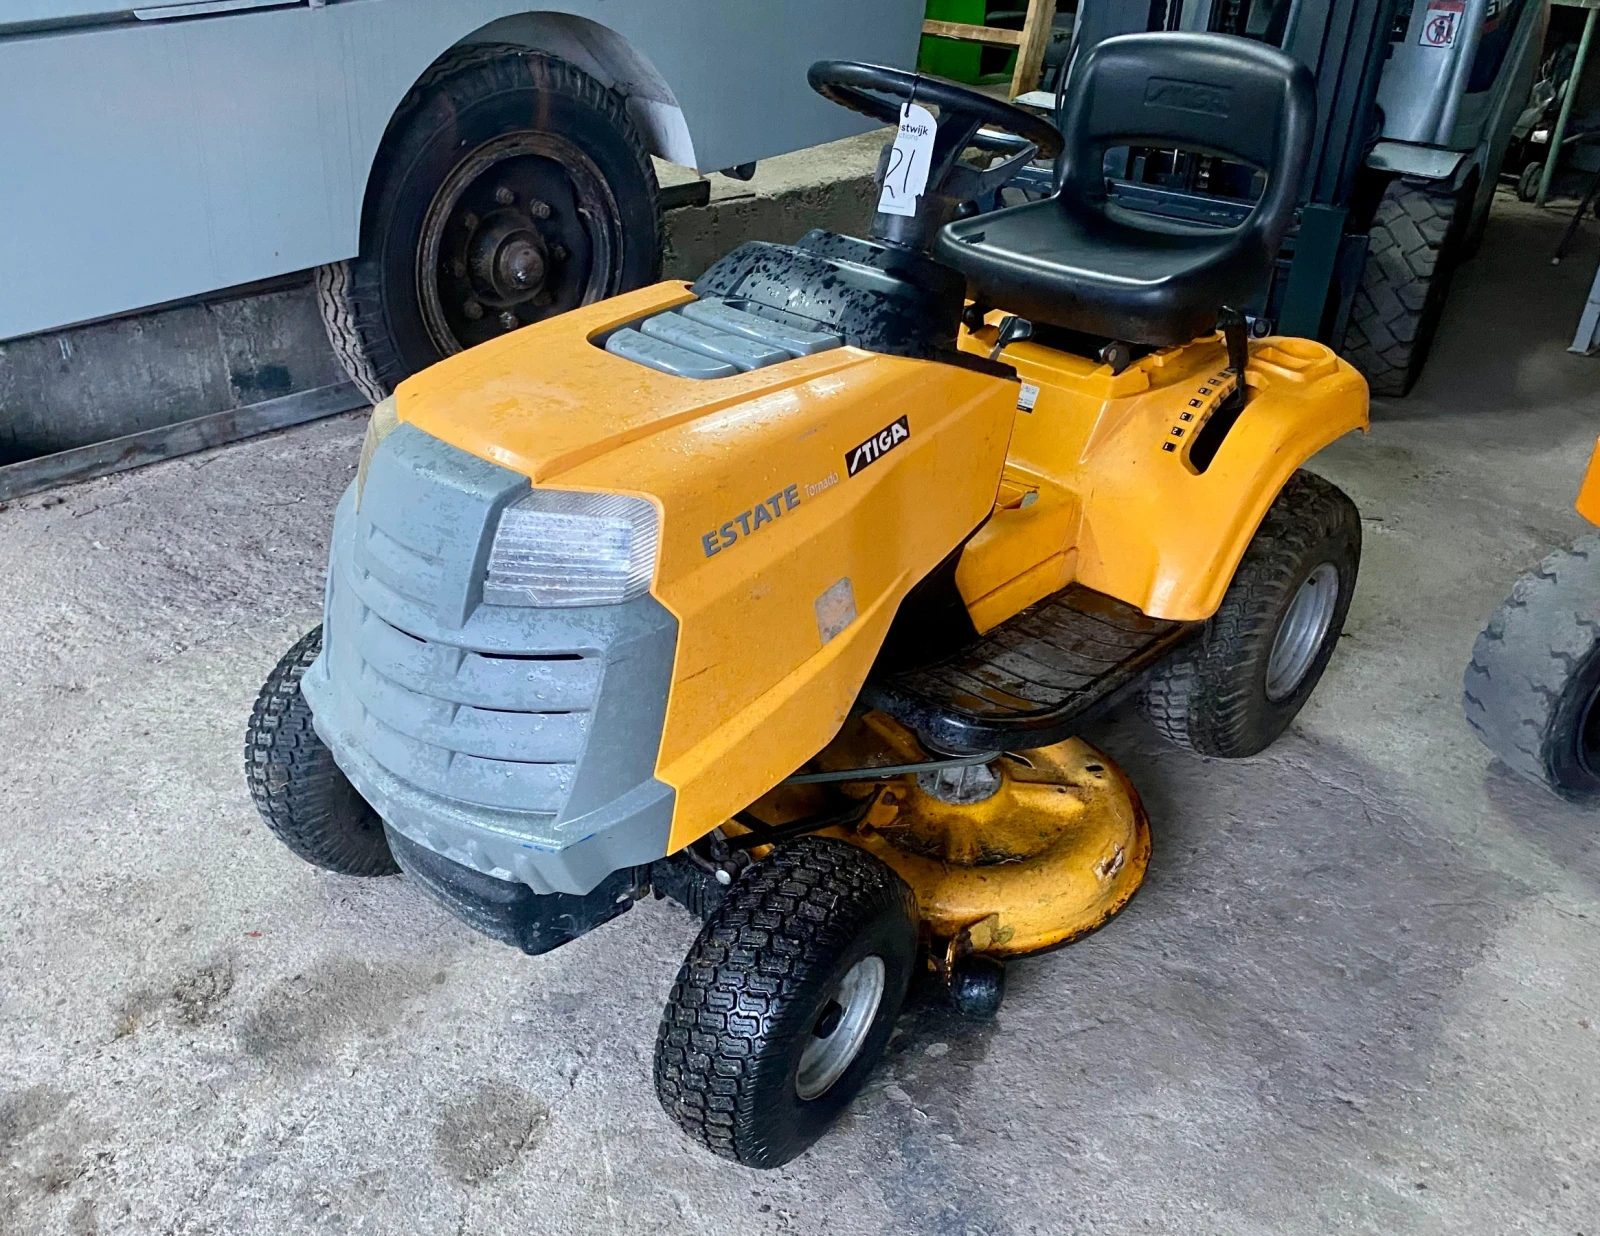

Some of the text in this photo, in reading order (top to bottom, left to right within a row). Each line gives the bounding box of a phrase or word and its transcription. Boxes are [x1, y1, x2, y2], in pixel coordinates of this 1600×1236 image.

[899, 122, 929, 137] stwijk
[850, 421, 908, 474] STIGA
[701, 470, 839, 558] ESTATE Tornado
